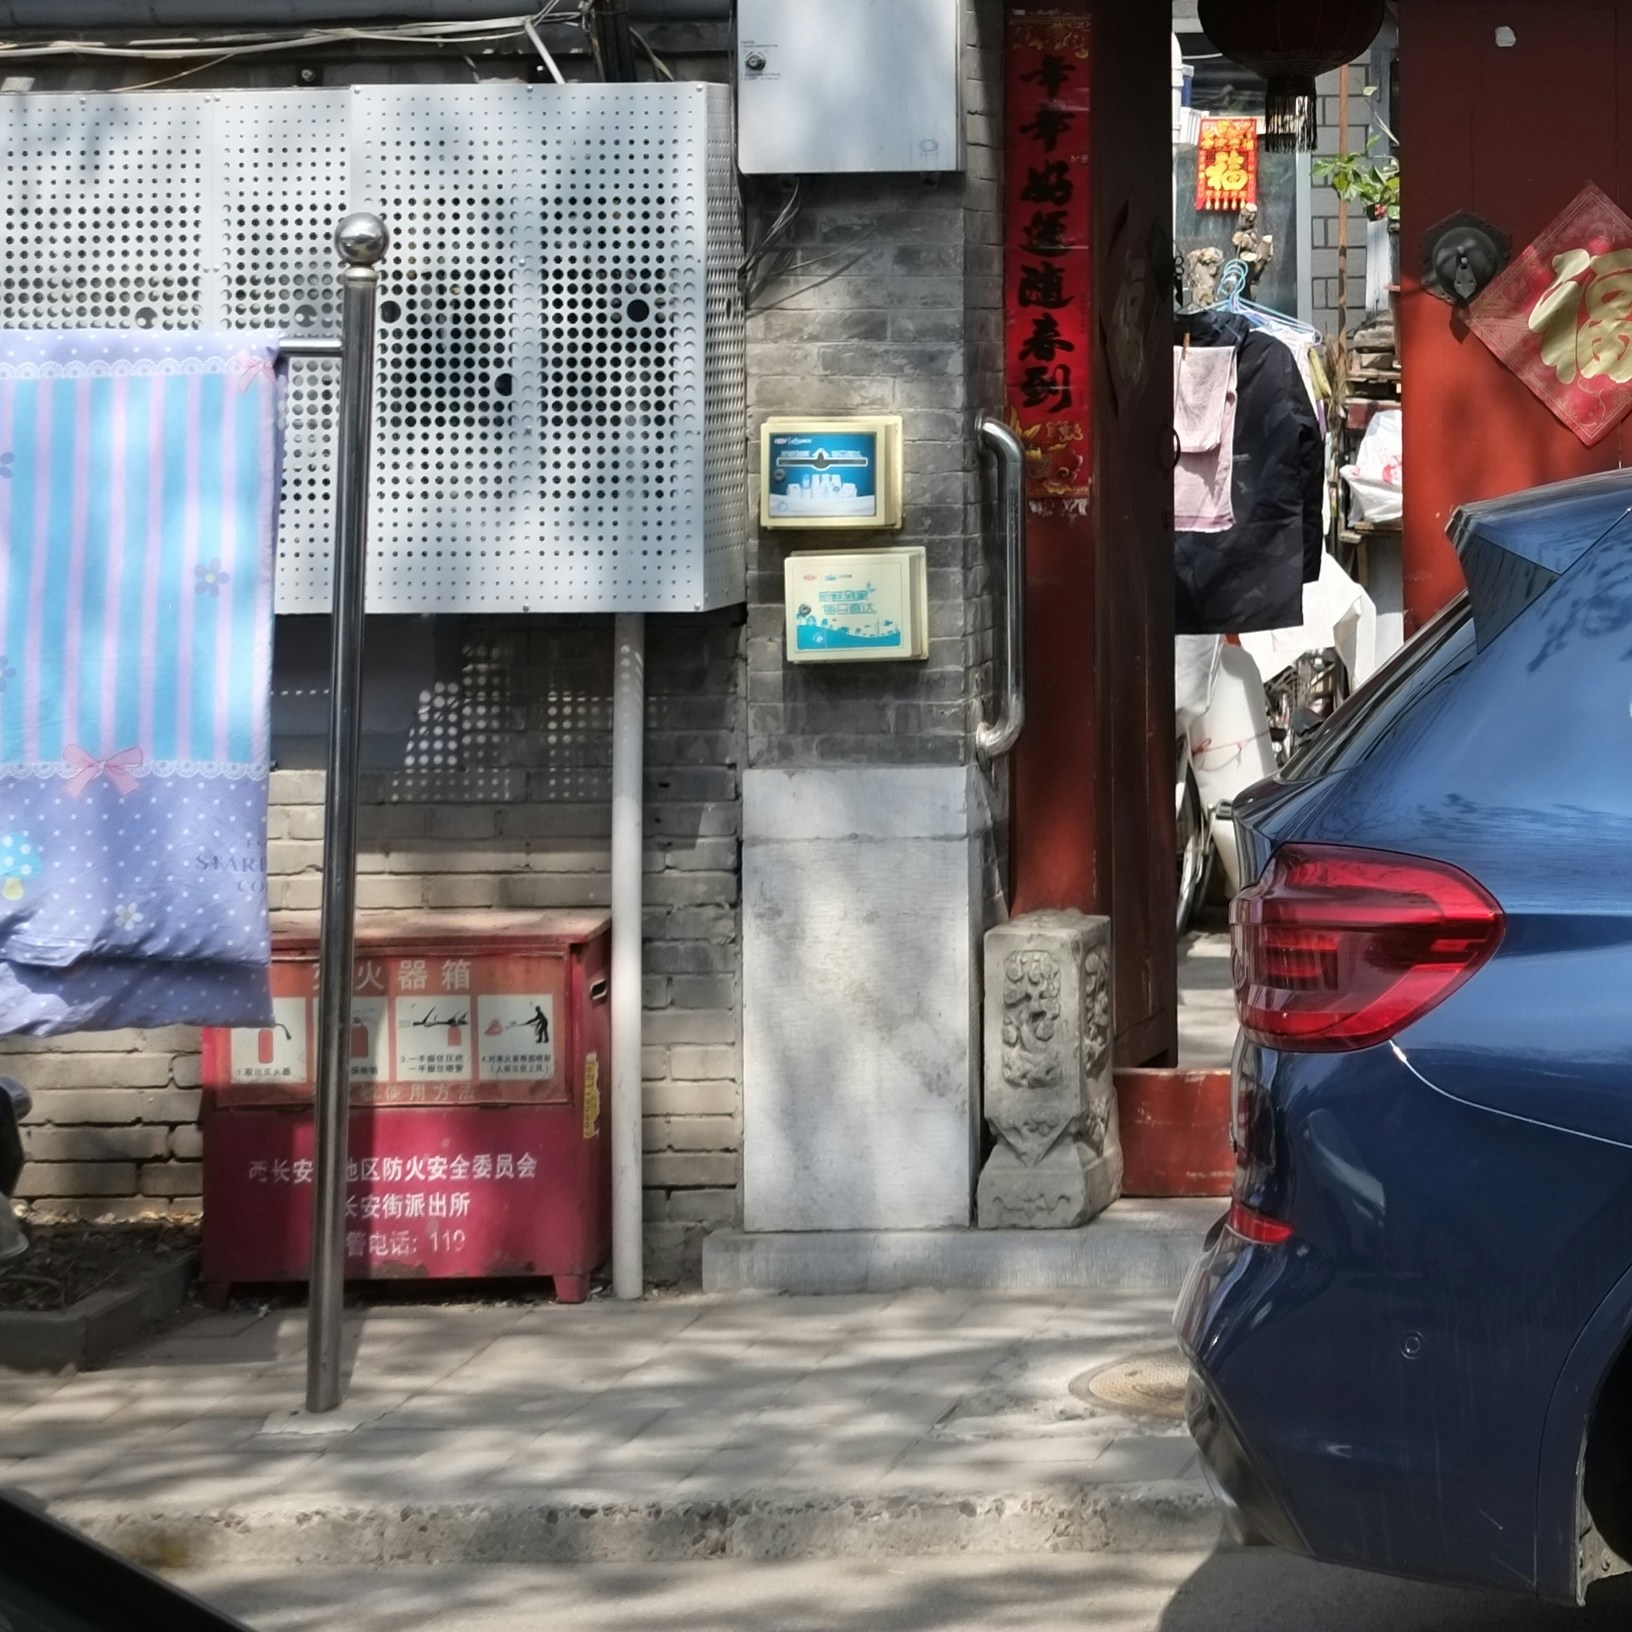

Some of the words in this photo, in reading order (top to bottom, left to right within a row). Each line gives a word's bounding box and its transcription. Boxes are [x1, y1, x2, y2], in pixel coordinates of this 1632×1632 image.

[1205, 149, 1248, 191] 福
[312, 958, 472, 991] 火器箱
[248, 1151, 538, 1184] 西长安地区防火安全委员会
[345, 1192, 471, 1219] 长安街派出所
